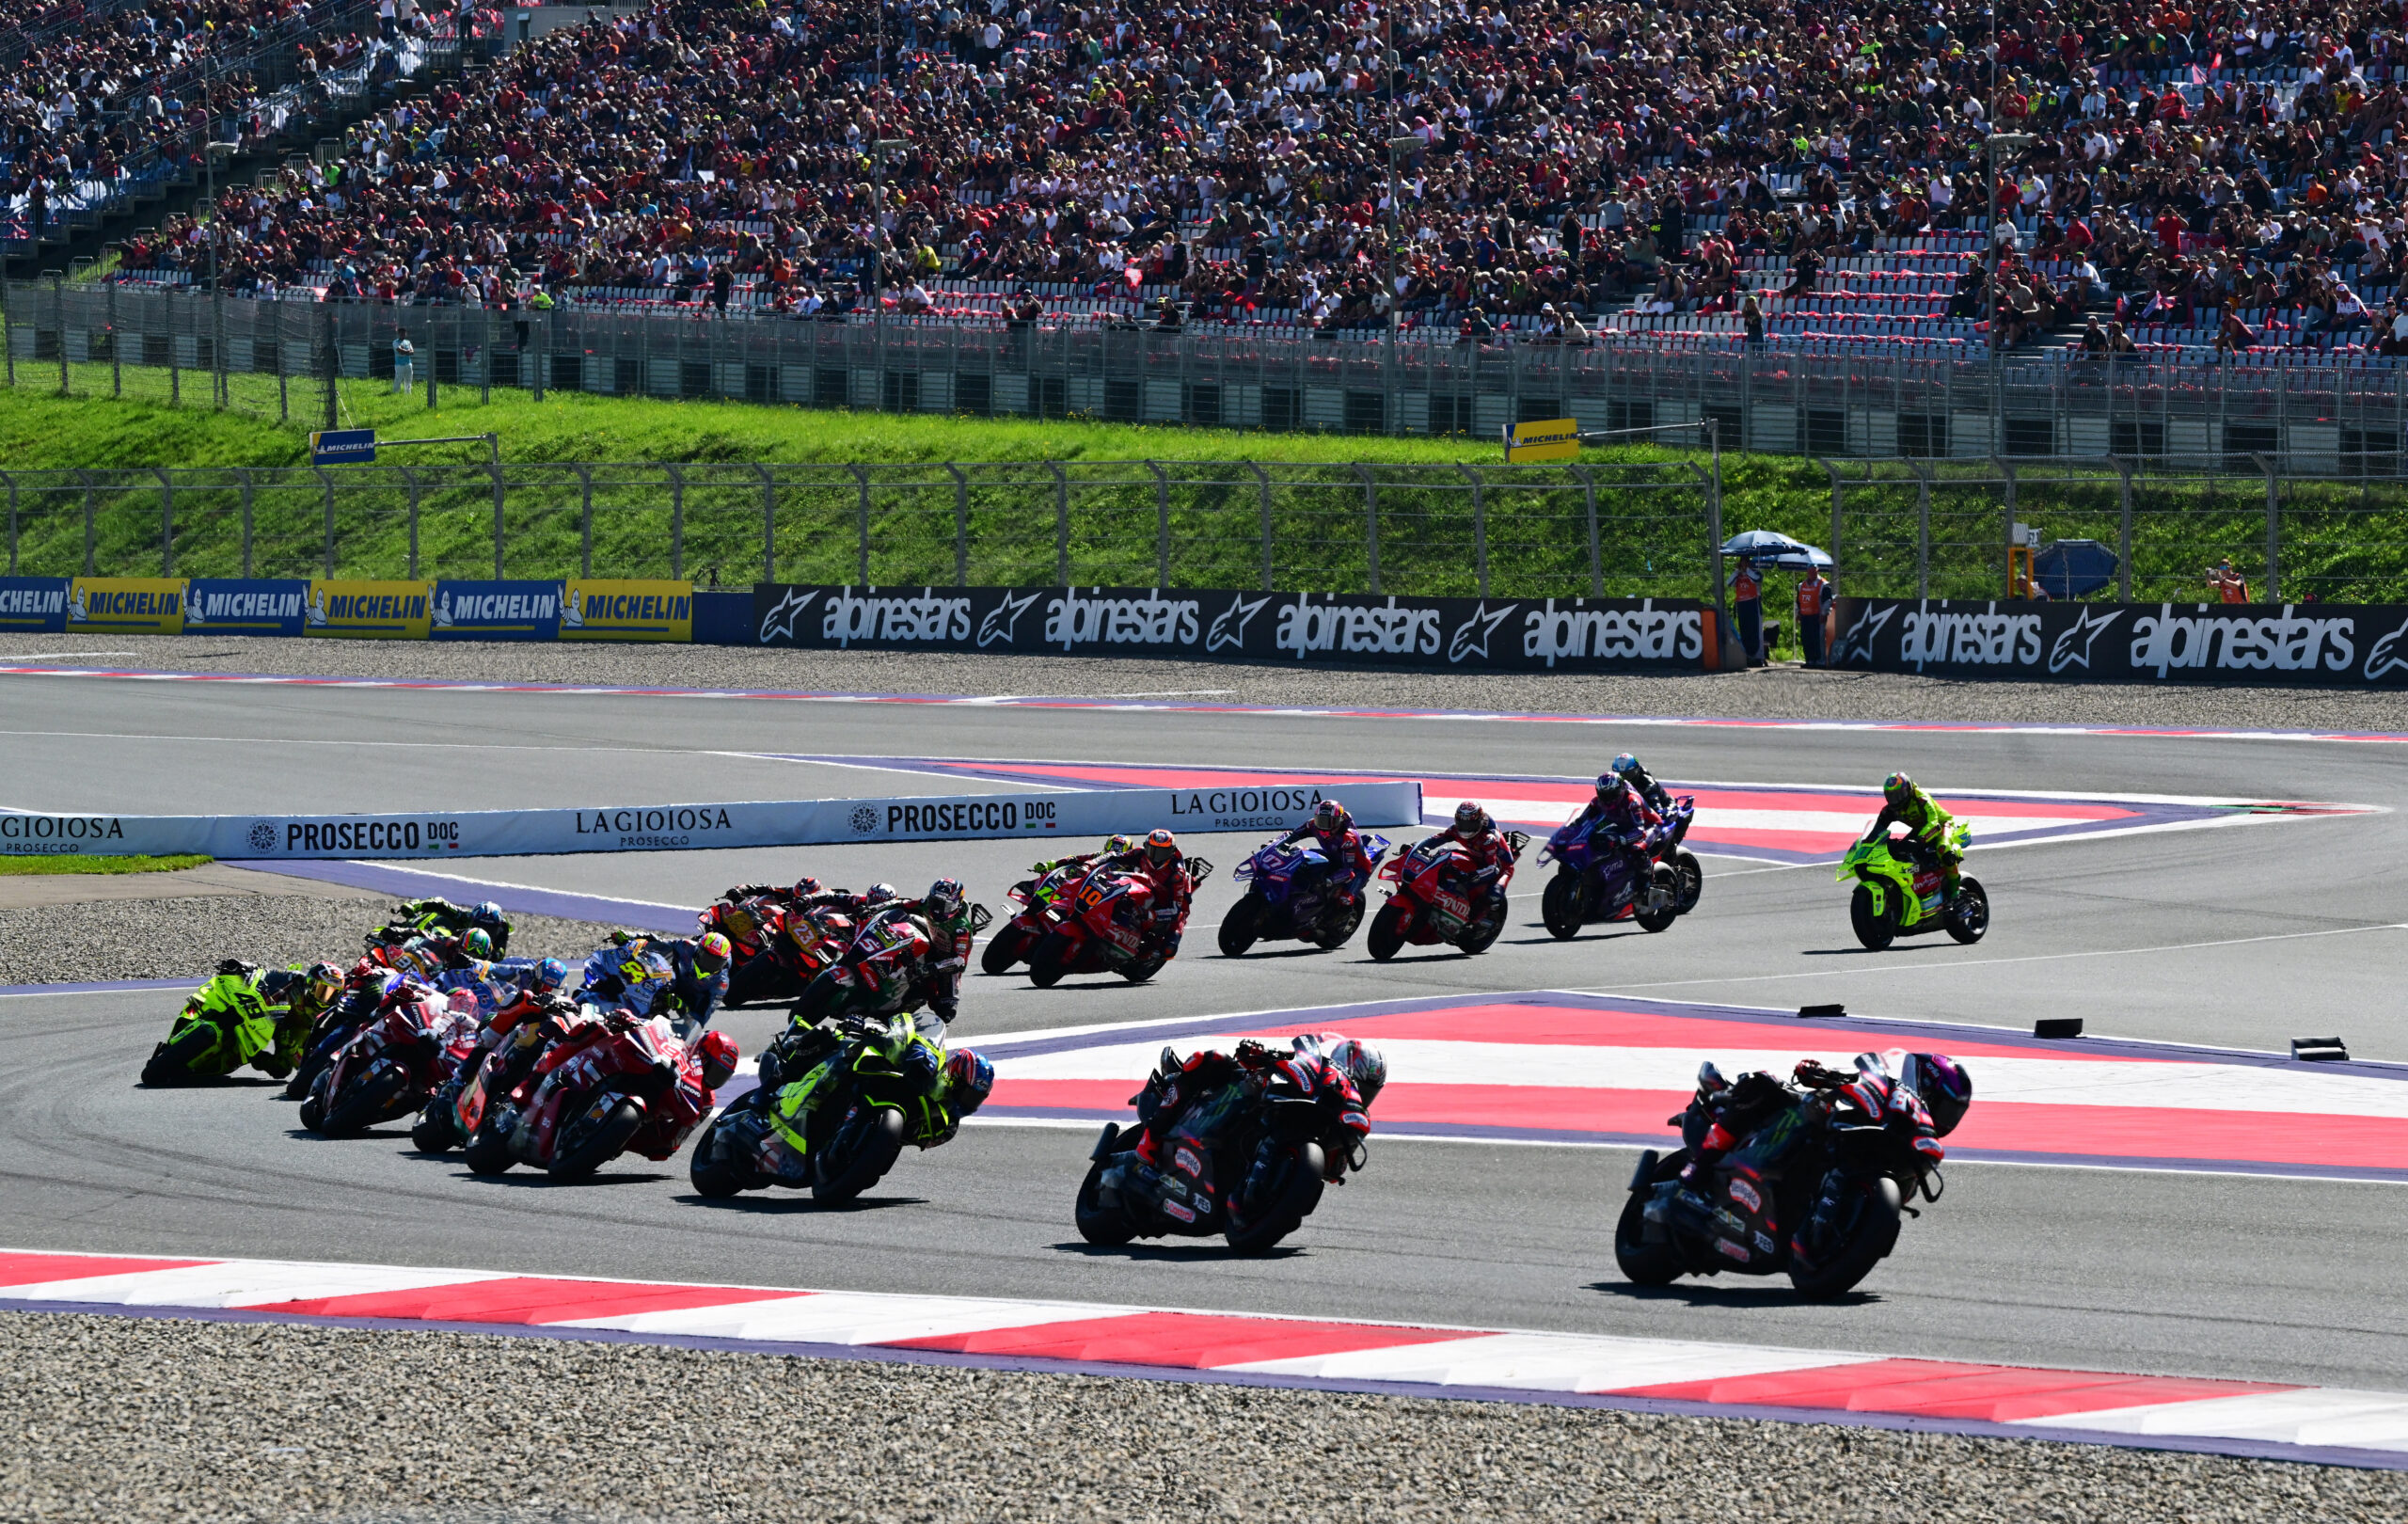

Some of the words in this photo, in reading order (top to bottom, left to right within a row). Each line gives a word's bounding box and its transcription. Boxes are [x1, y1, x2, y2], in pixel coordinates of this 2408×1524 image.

[327, 442, 374, 452] MICHELIN
[1523, 433, 1577, 444] MICHELIN
[91, 592, 180, 615] MICHELIN
[206, 594, 301, 617] MICHELIN
[330, 595, 425, 619] MICHELIN
[454, 595, 555, 619] MICHELIN
[585, 595, 690, 620] MICHELIN
[823, 586, 971, 648] alpinestars
[1046, 587, 1199, 651] alpinestars
[1276, 593, 1440, 659] alpinestars
[1524, 598, 1703, 667] alpinestars
[1902, 599, 2041, 672] alpinestars
[2131, 603, 2354, 678] alpinestars
[1, 817, 123, 838] GIOIOSA
[888, 802, 1017, 832] PROSECCO
[1025, 802, 1055, 819] DOC
[1215, 817, 1283, 828] PROSECCO
[6, 843, 79, 853] PROSECCO
[287, 822, 420, 851] PROSECCO
[428, 822, 458, 840] DOC
[621, 835, 689, 847] PROSECCO
[1078, 886, 1102, 907] 10
[793, 924, 816, 945] 23
[619, 960, 647, 984] 54
[411, 1005, 423, 1029] Lenovo
[680, 1082, 702, 1098] Lenovo
